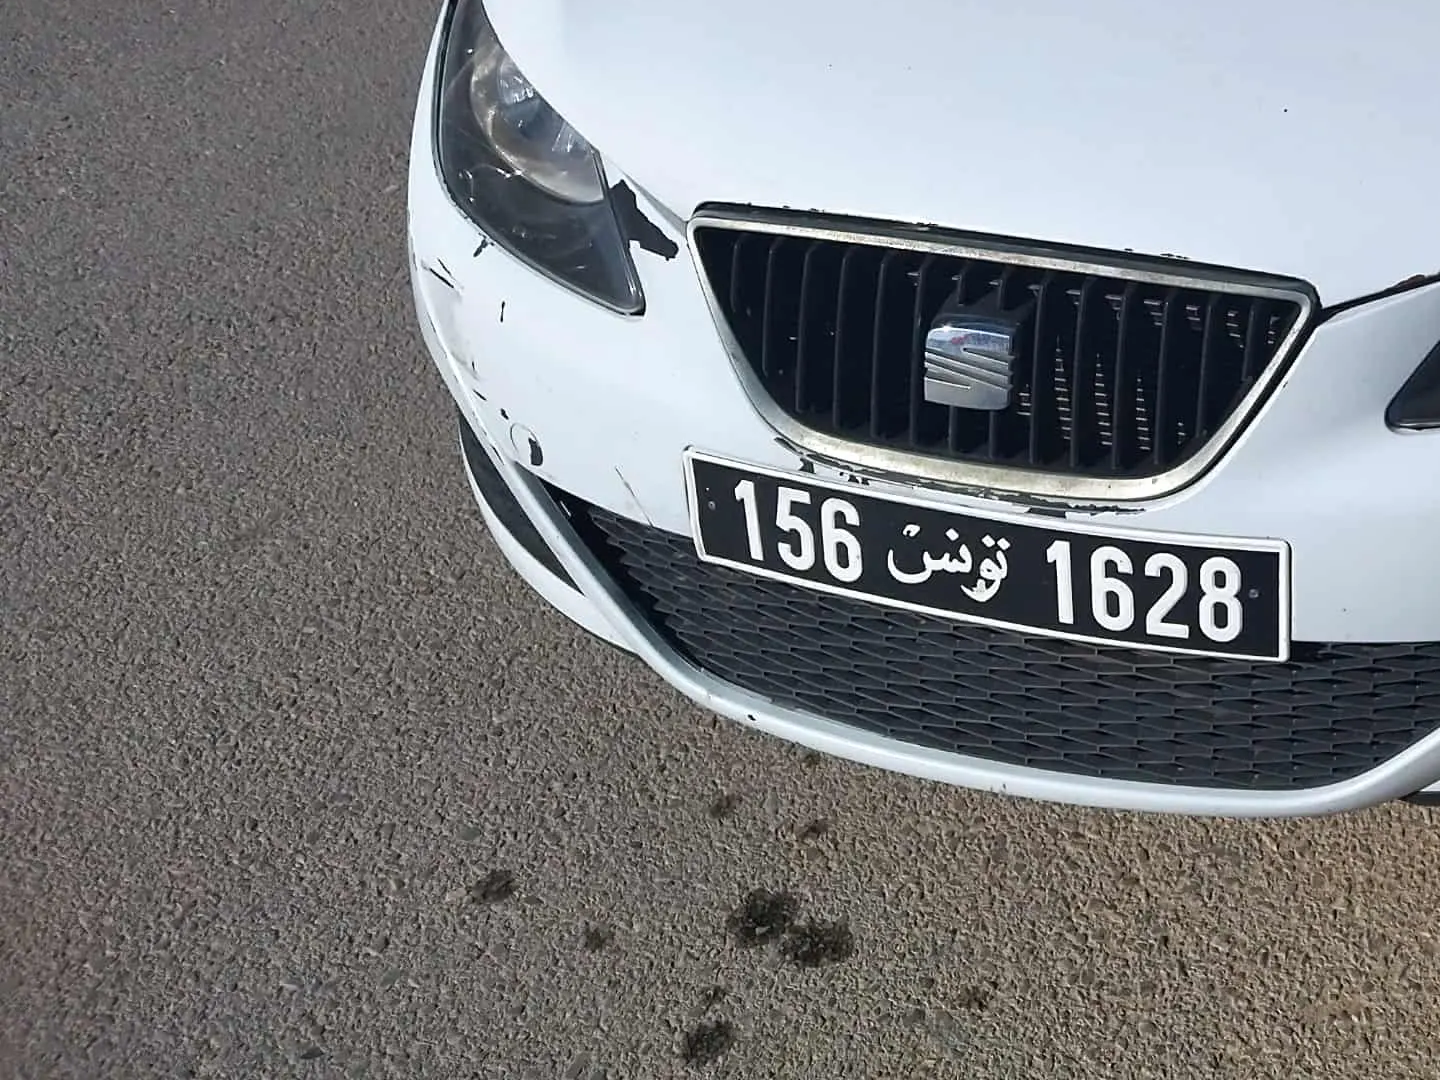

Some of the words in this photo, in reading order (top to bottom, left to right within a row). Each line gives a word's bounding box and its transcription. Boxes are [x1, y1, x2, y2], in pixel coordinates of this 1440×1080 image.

[734, 479, 864, 582] 156
[887, 523, 1011, 602] تونس
[1046, 539, 1243, 643] 1628
